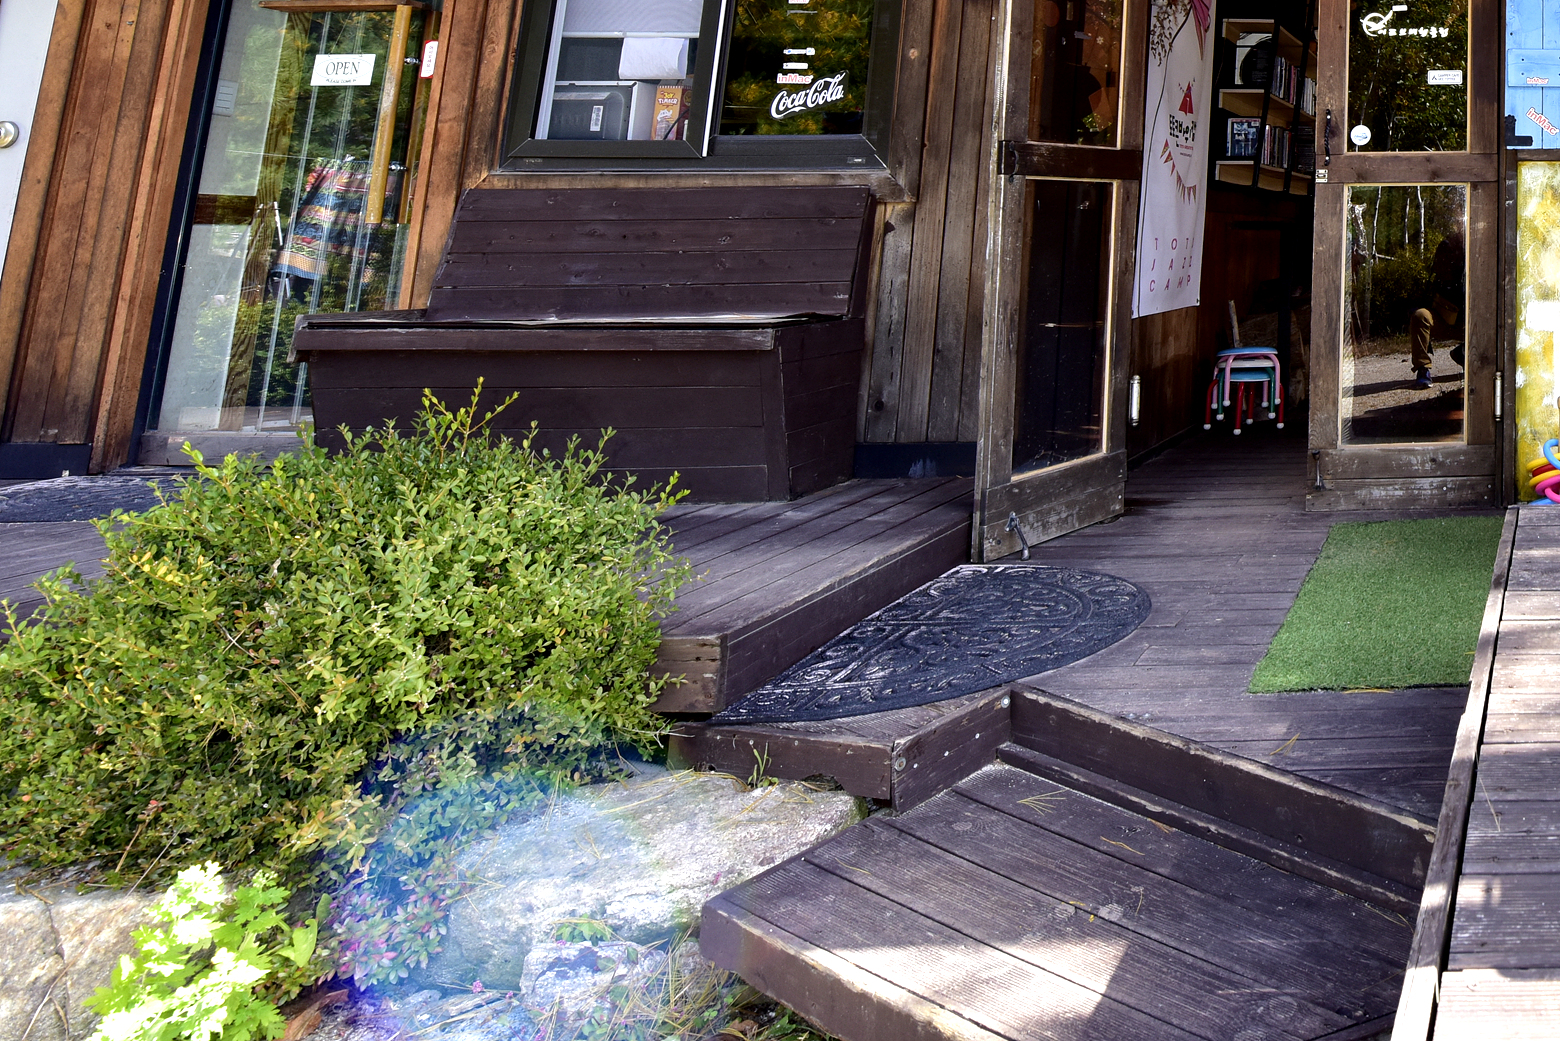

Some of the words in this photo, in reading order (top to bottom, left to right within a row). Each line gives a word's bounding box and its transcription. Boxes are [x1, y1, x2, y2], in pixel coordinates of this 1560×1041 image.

[325, 61, 361, 76] OPEN
[777, 74, 811, 83] inMac
[770, 71, 847, 119] Coca-Cola
[1527, 108, 1557, 135] inMac
[1150, 255, 1193, 272] JAZZ
[1149, 274, 1191, 293] CAMP
